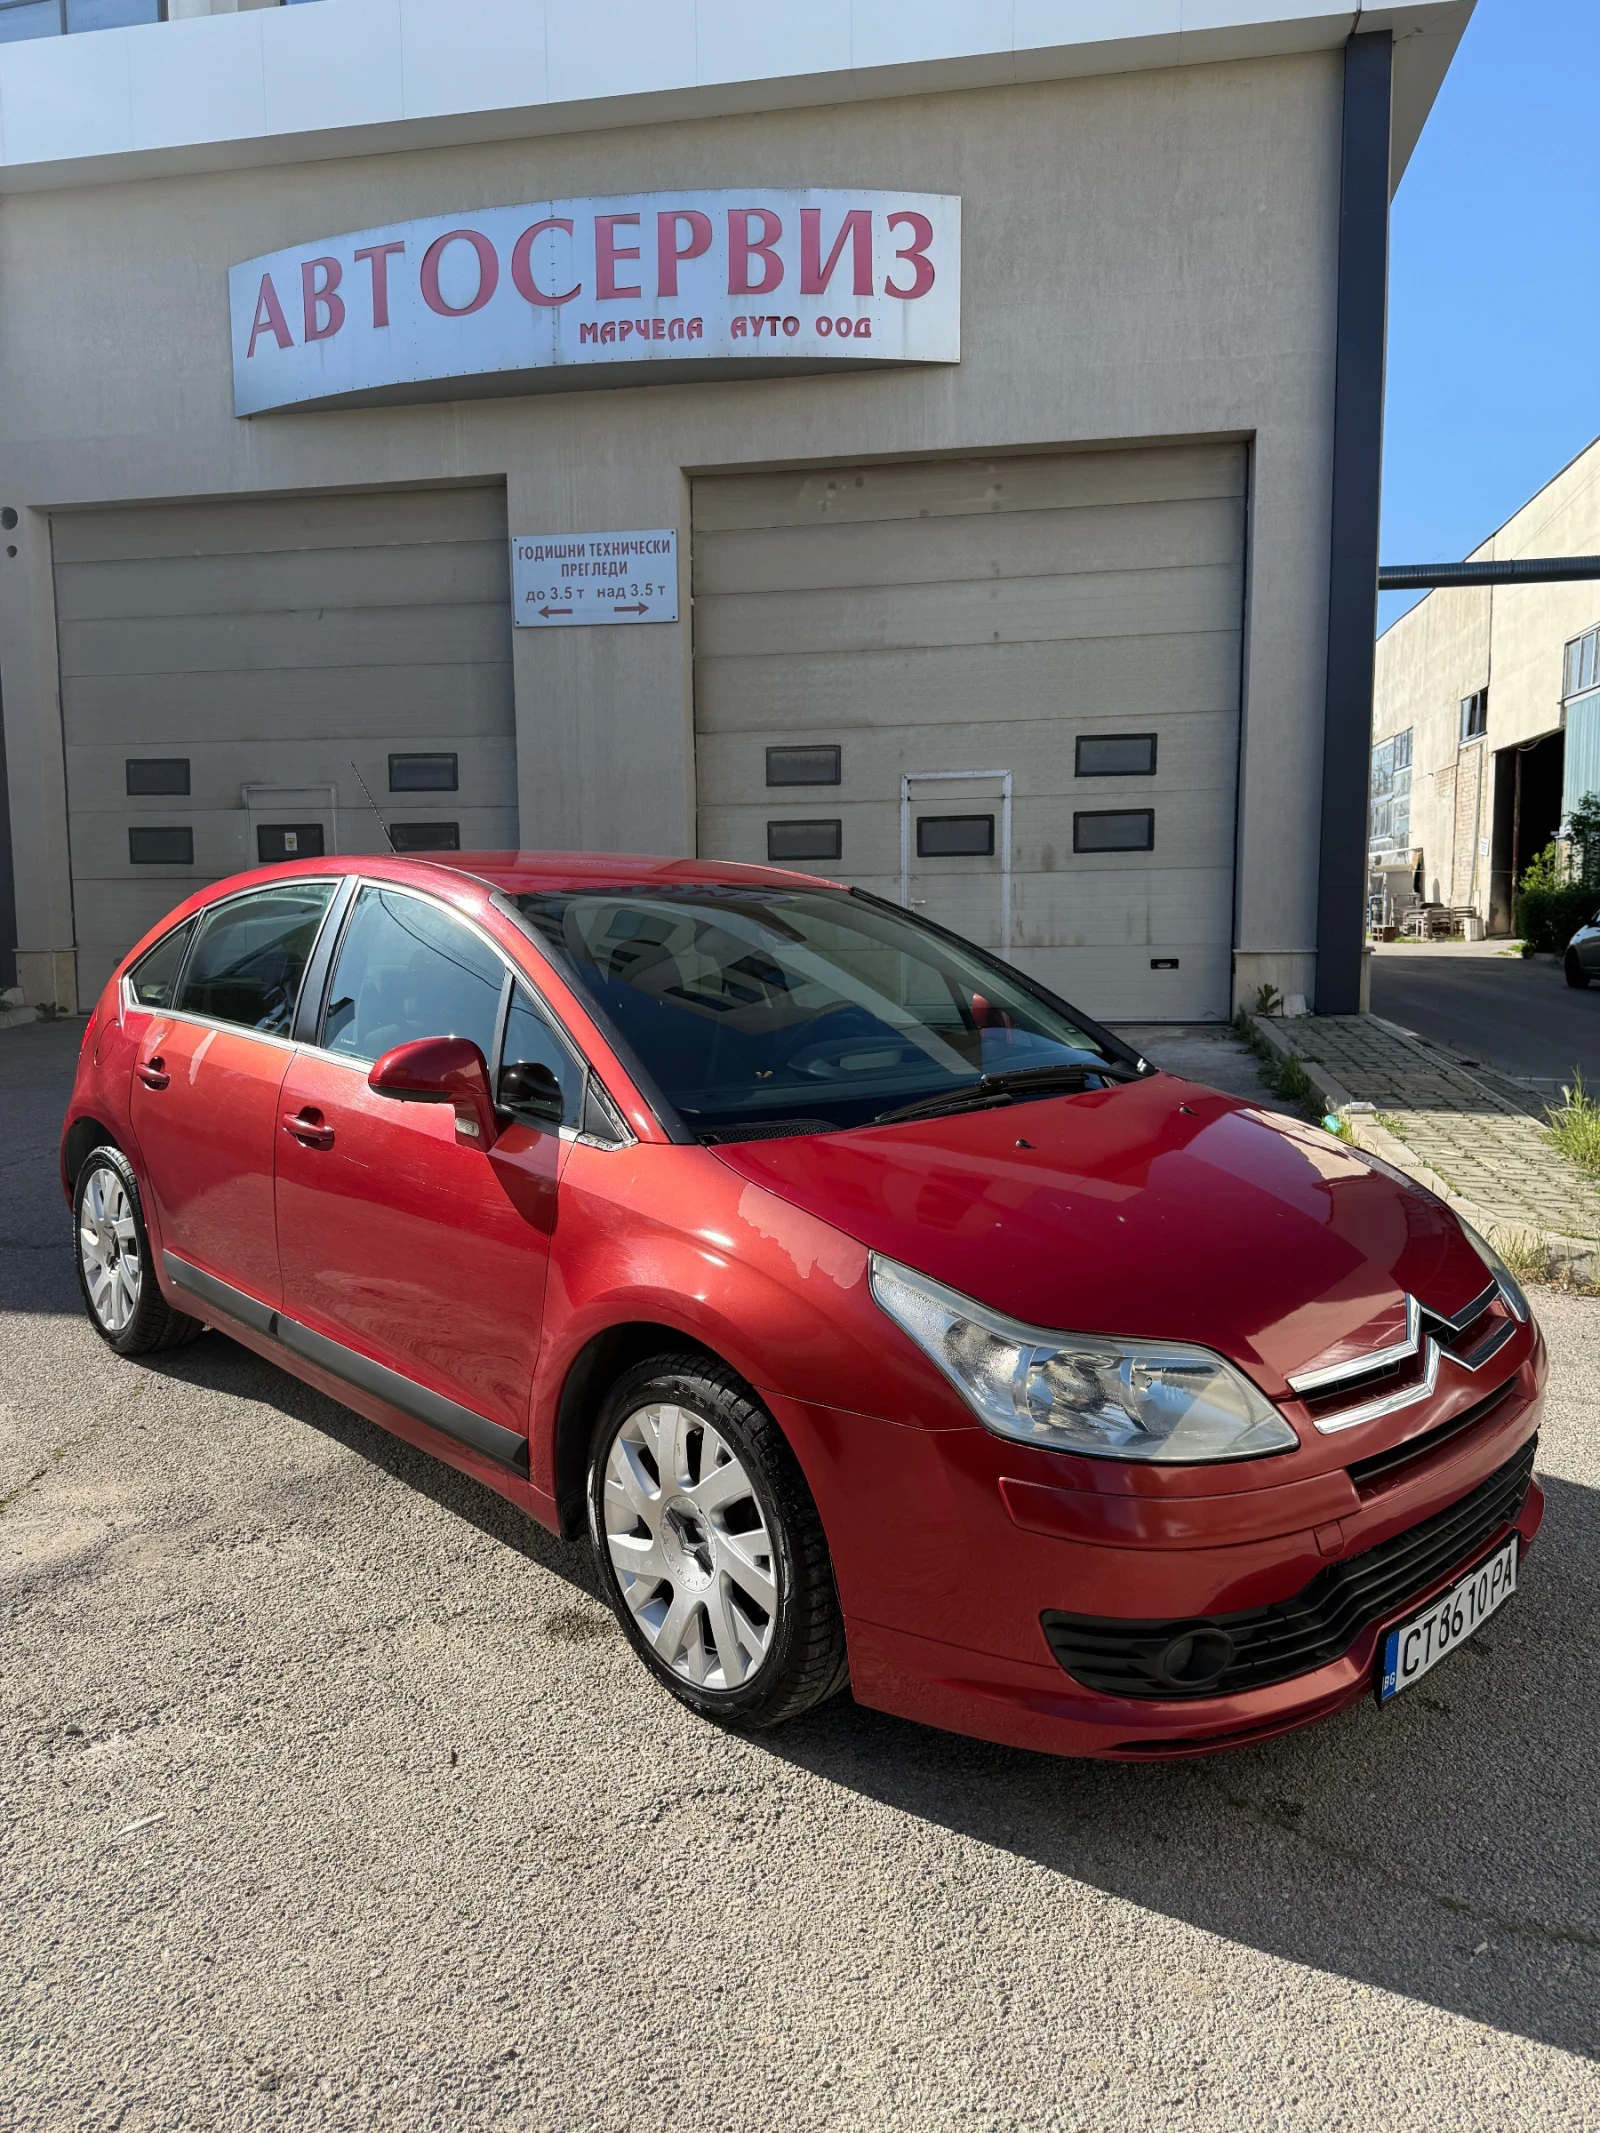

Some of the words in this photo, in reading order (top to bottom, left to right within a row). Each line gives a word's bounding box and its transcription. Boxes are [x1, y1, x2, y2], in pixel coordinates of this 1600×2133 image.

[247, 207, 936, 358] АВТОСЕРВИЗ
[579, 317, 704, 345] МАРЧЕЛА
[730, 315, 800, 340] АУТО
[815, 315, 872, 339] ООД
[518, 543, 586, 562] ГОДИШНИ
[589, 539, 671, 557] ТЕХНИЧЕСКИ
[561, 561, 628, 578] ПРЕГЛЕДИ
[525, 590, 546, 603] до
[550, 586, 573, 600] 3.5
[597, 586, 626, 599] над
[630, 583, 653, 597] 3.5
[1384, 1671, 1396, 1691] BG
